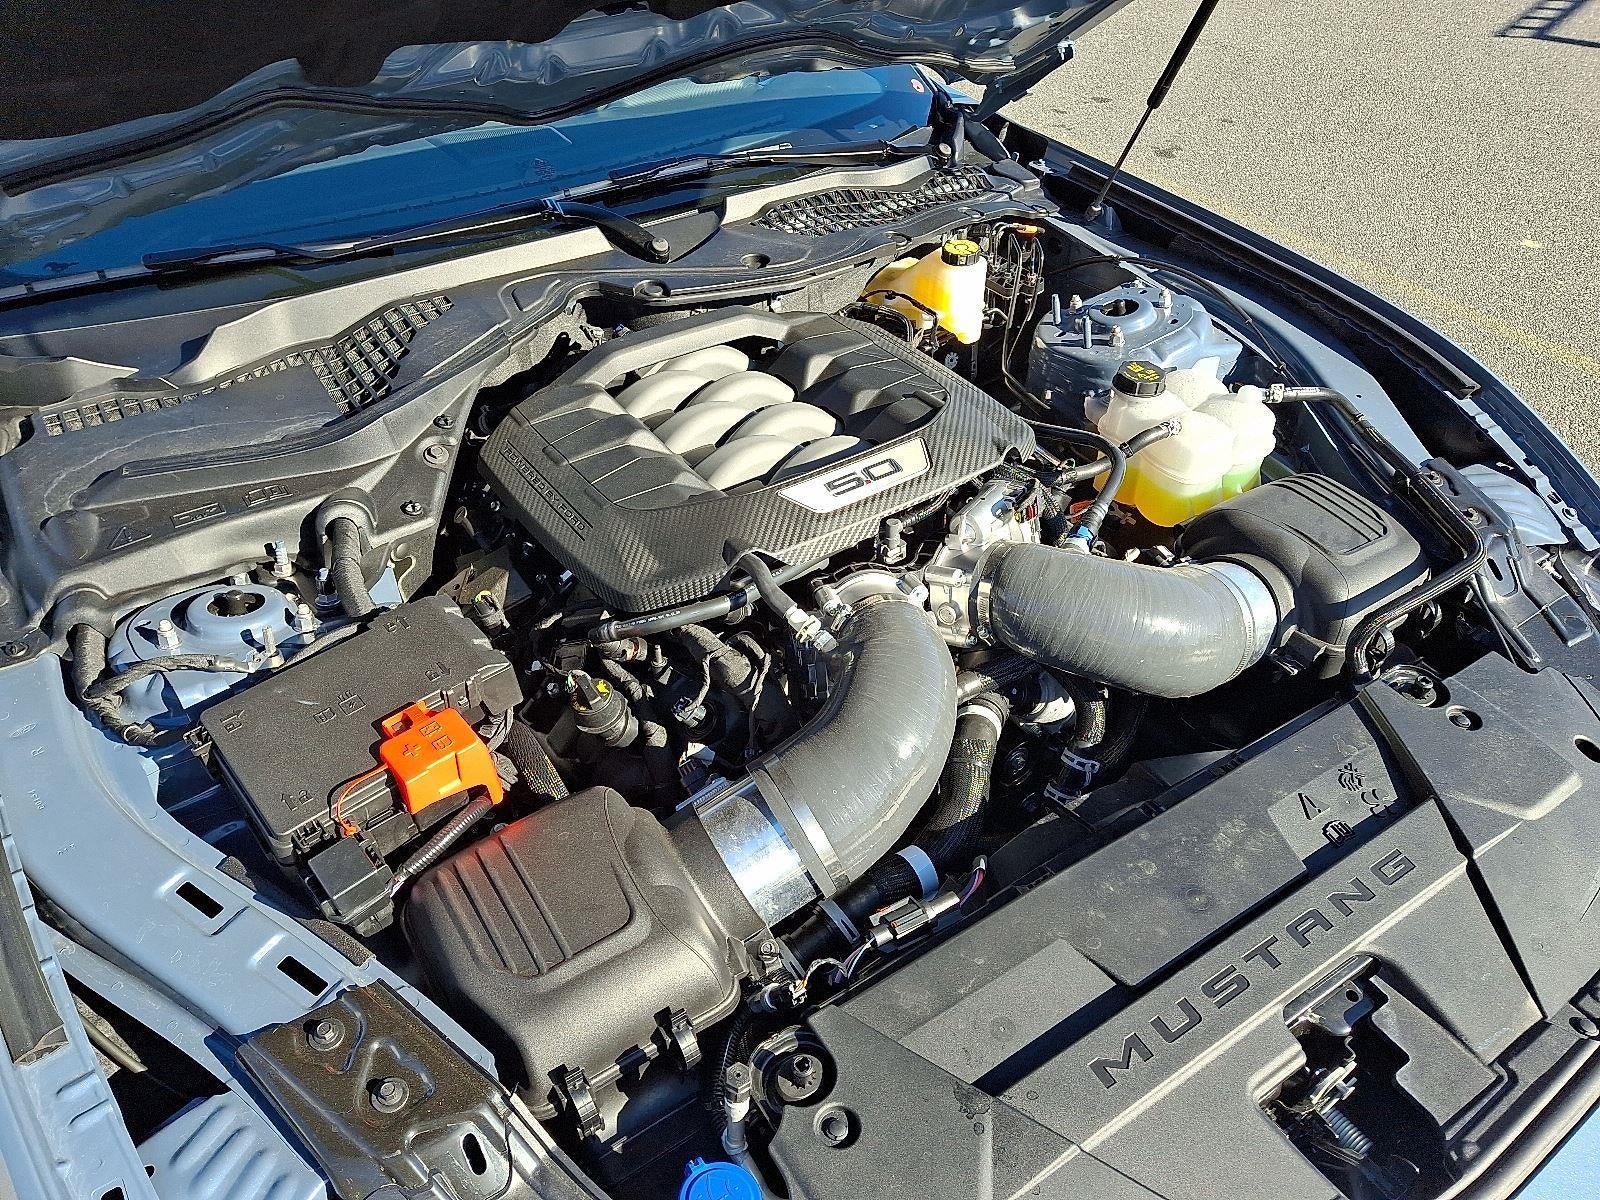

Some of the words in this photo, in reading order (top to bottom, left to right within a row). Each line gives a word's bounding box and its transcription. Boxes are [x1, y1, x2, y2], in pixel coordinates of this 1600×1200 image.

[503, 447, 546, 490] POWERED
[544, 489, 560, 502] BY
[558, 503, 586, 531] FORD
[824, 457, 903, 498] 5.0
[1087, 848, 1417, 1089] MUSTANG
